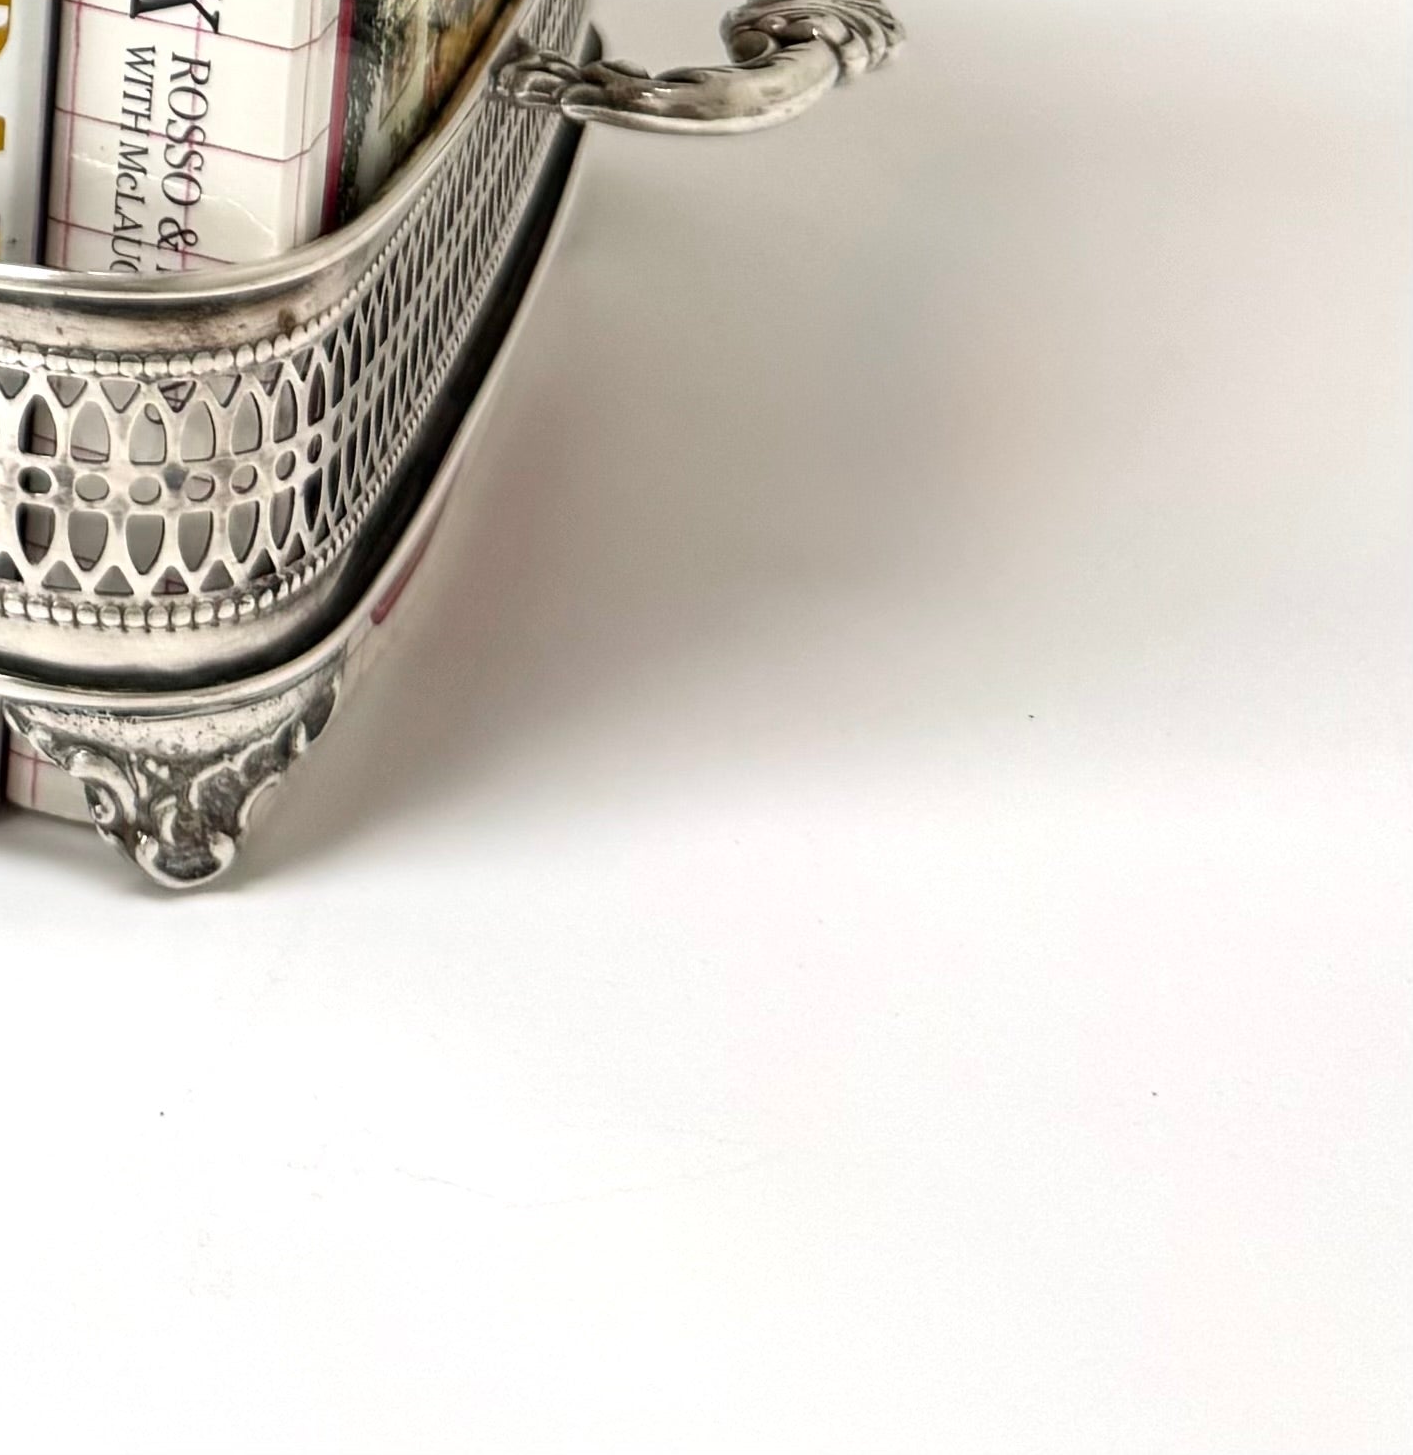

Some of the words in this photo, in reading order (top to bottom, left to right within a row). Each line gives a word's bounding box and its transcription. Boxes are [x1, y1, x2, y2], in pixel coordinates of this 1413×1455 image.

[119, 44, 156, 138] WITH
[160, 51, 212, 208] ROSSO
[156, 216, 199, 253] &
